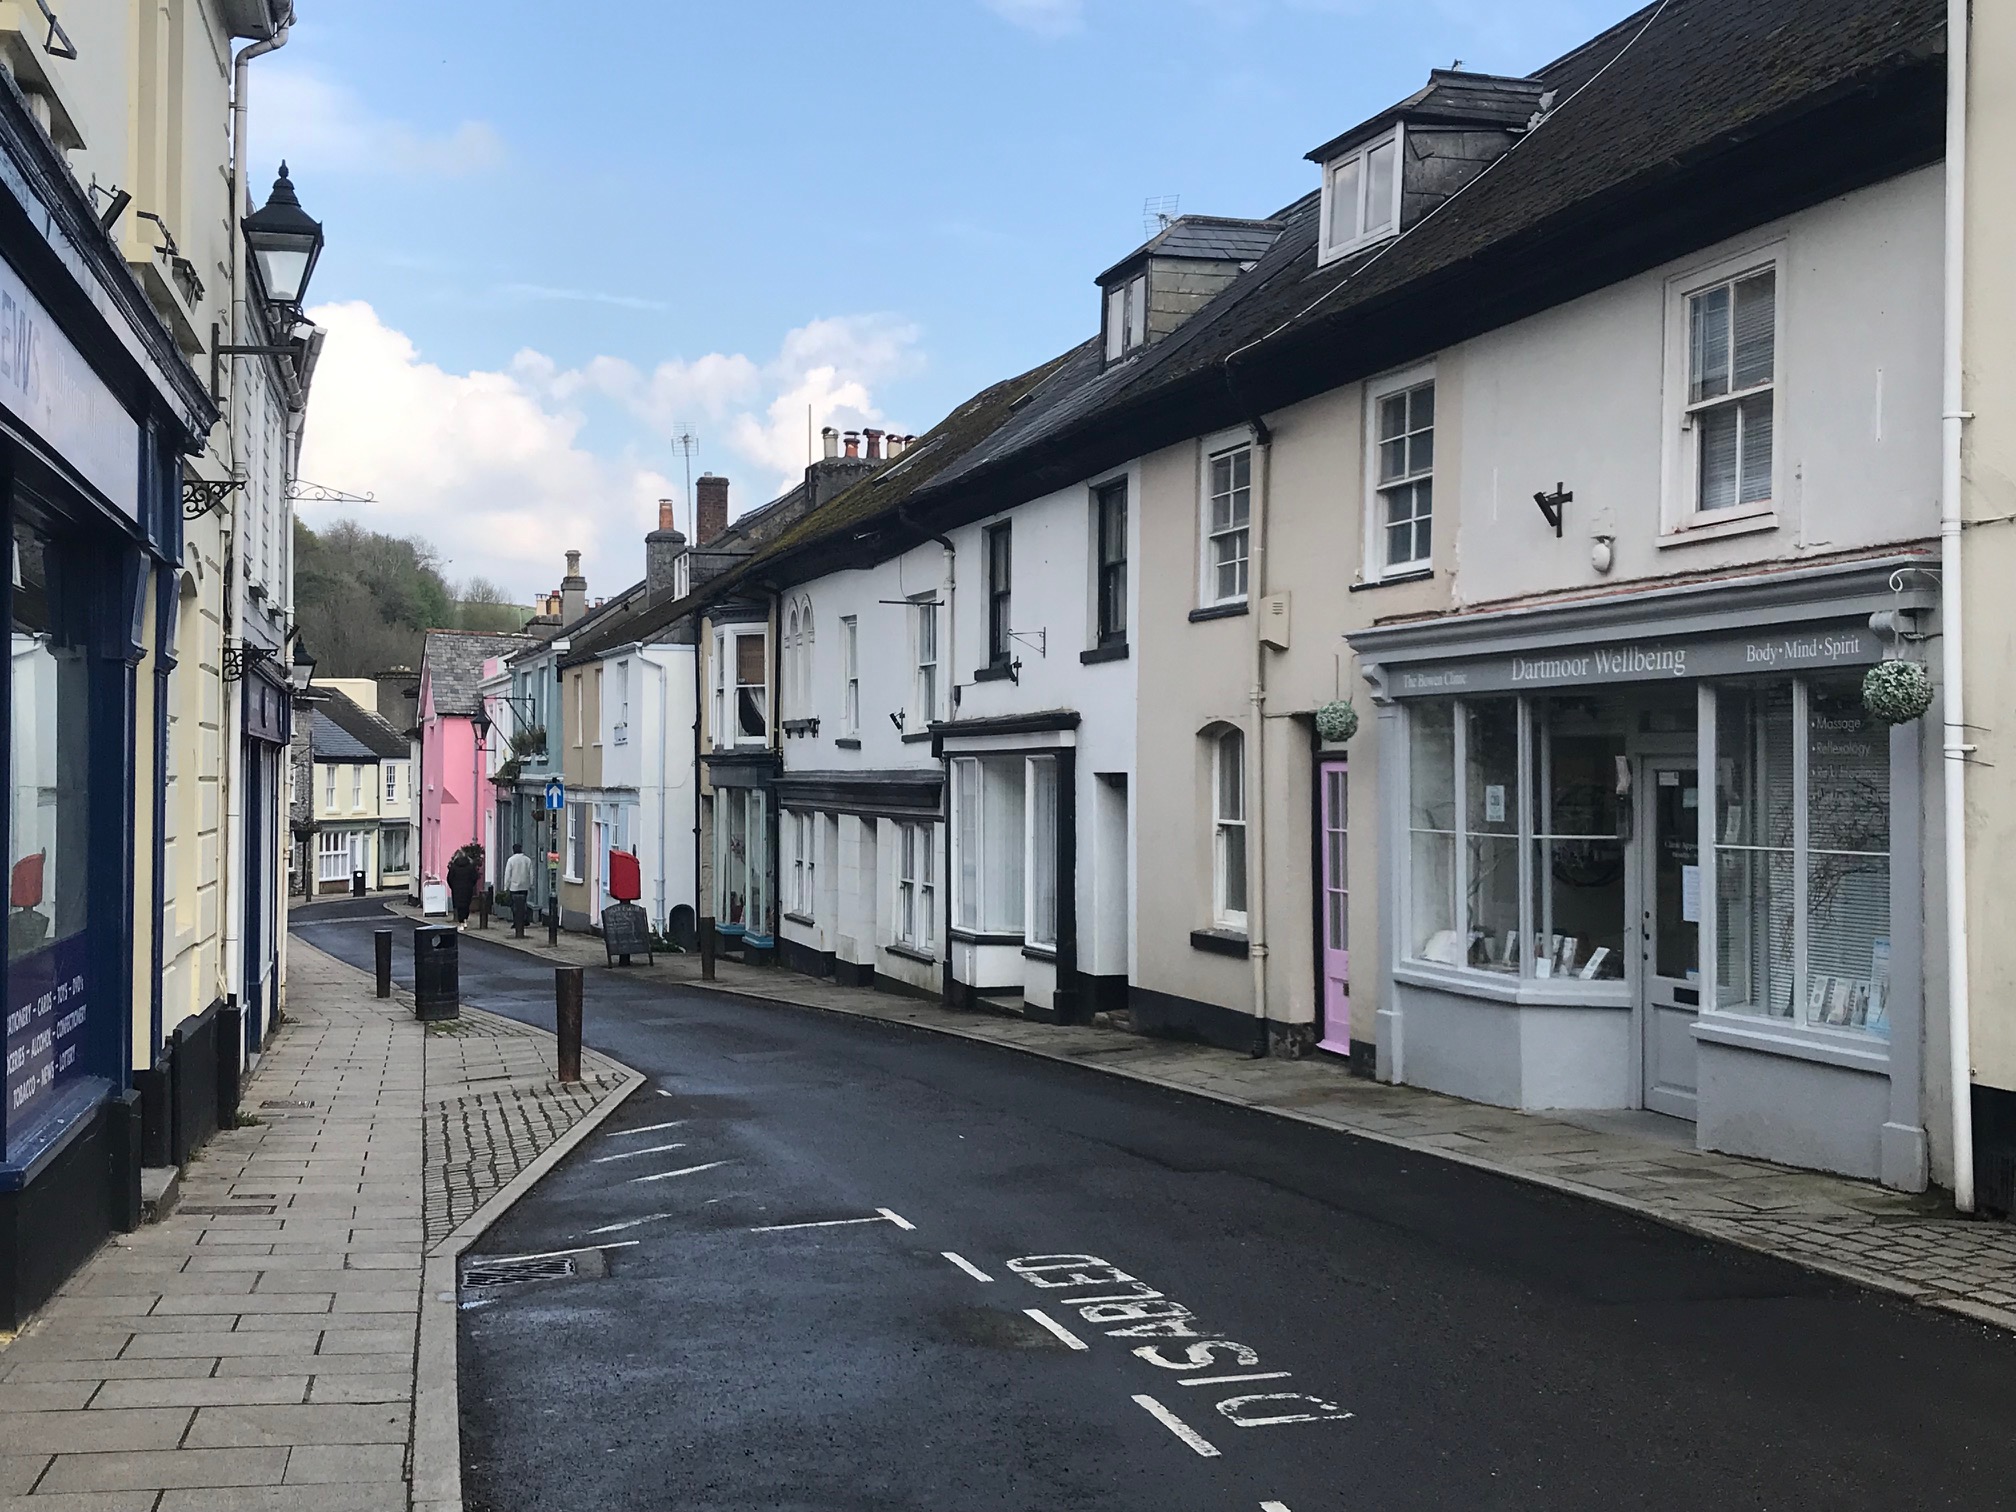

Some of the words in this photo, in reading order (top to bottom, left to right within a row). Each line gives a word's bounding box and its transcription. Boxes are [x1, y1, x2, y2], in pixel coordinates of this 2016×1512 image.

[1403, 674, 1417, 688] The
[1511, 656, 1590, 681] Dartmoor
[1594, 644, 1686, 676] Wellbeing
[1817, 717, 1861, 733] Massage
[37, 991, 53, 1017] CARDS
[30, 1027, 52, 1059] ALCOHOL
[56, 1003, 87, 1040] CONFECTIONERY
[13, 1074, 36, 1110] TOBACCO
[41, 1060, 55, 1087] NEWS
[59, 1043, 76, 1073] LOTTERY
[1005, 1253, 1356, 1428] DISABLED
